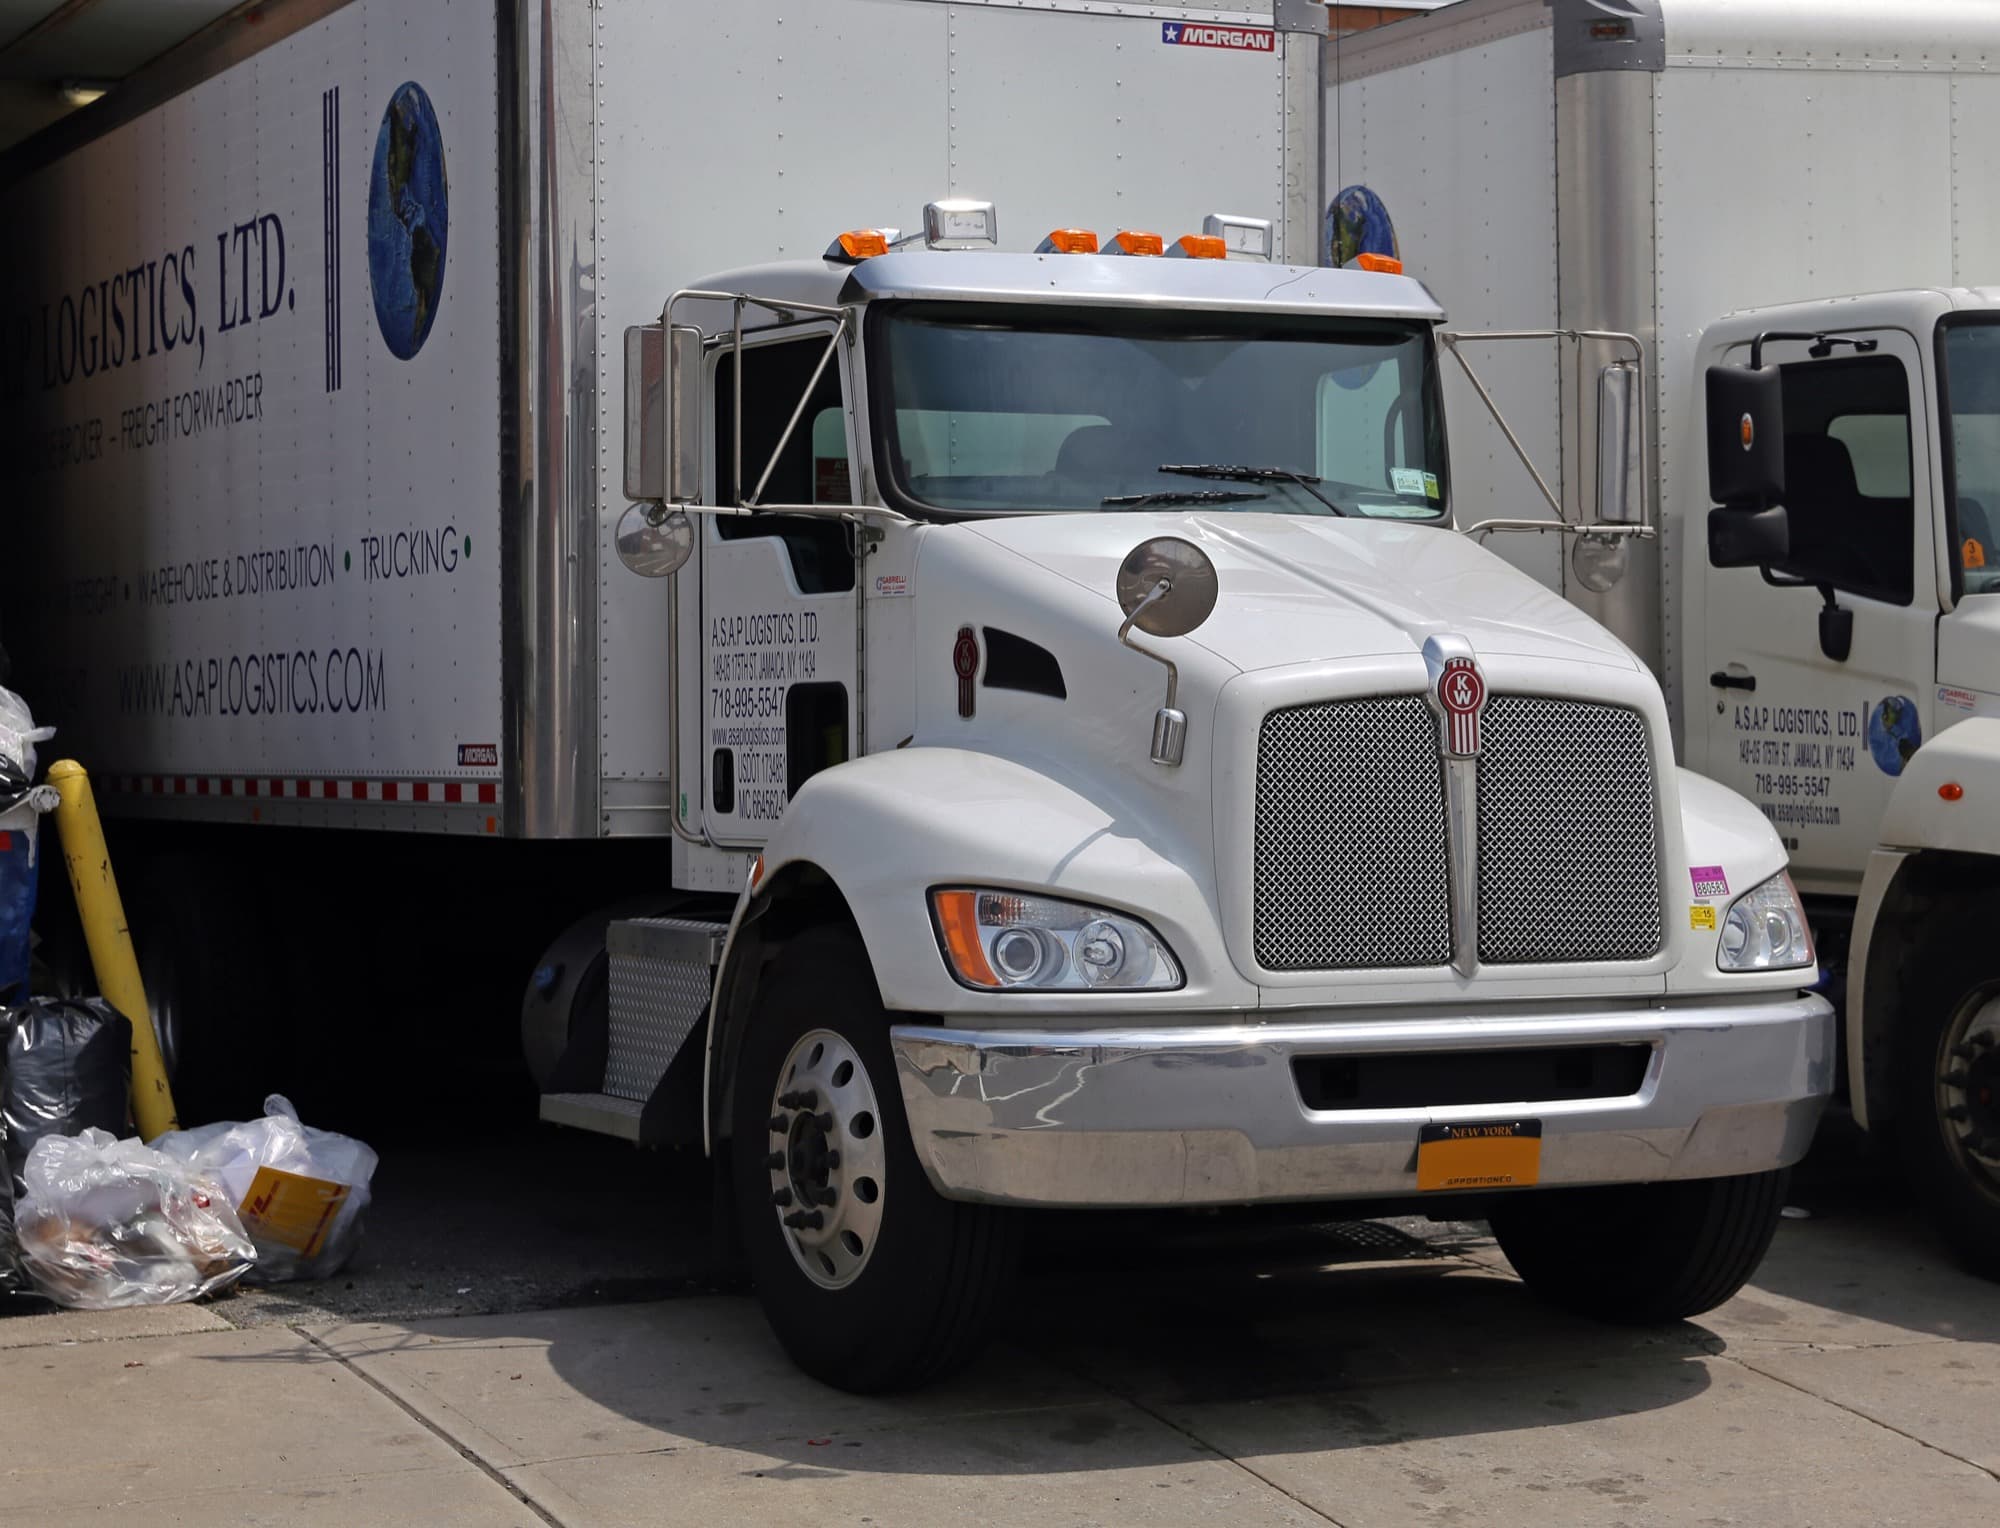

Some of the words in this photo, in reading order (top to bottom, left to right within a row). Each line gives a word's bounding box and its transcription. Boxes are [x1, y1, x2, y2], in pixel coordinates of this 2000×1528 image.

[1183, 27, 1270, 49] MORGAN
[42, 245, 205, 391] LOGISTICS,
[217, 213, 295, 333] LTD.
[121, 398, 170, 451] FREIGHT
[174, 371, 263, 439] FORWARDER
[138, 558, 219, 608] WAREHOUSE
[223, 564, 233, 599] &
[237, 541, 335, 596] DISTRIBUTION
[361, 525, 459, 584] TRUCKING
[712, 616, 743, 648] A.S.A.P
[745, 612, 796, 648] LOGISTICS,
[799, 611, 820, 643] LTD.
[119, 647, 385, 717] WWW.ASAPLOGISTICS.COM
[1453, 690, 1471, 705] W
[1456, 675, 1468, 690] K
[712, 686, 785, 718] 718-995-5547
[712, 721, 785, 752] www.asaplogistics.com
[1735, 705, 1768, 731] A.S.A.P
[1838, 711, 1860, 737] LTD.
[464, 747, 497, 764] MORGAN
[737, 752, 759, 784] USDOT
[1755, 773, 1830, 797] 718-995-5547
[738, 789, 751, 820] MC
[1452, 1126, 1480, 1138] NEW
[1483, 1125, 1513, 1137] YORK
